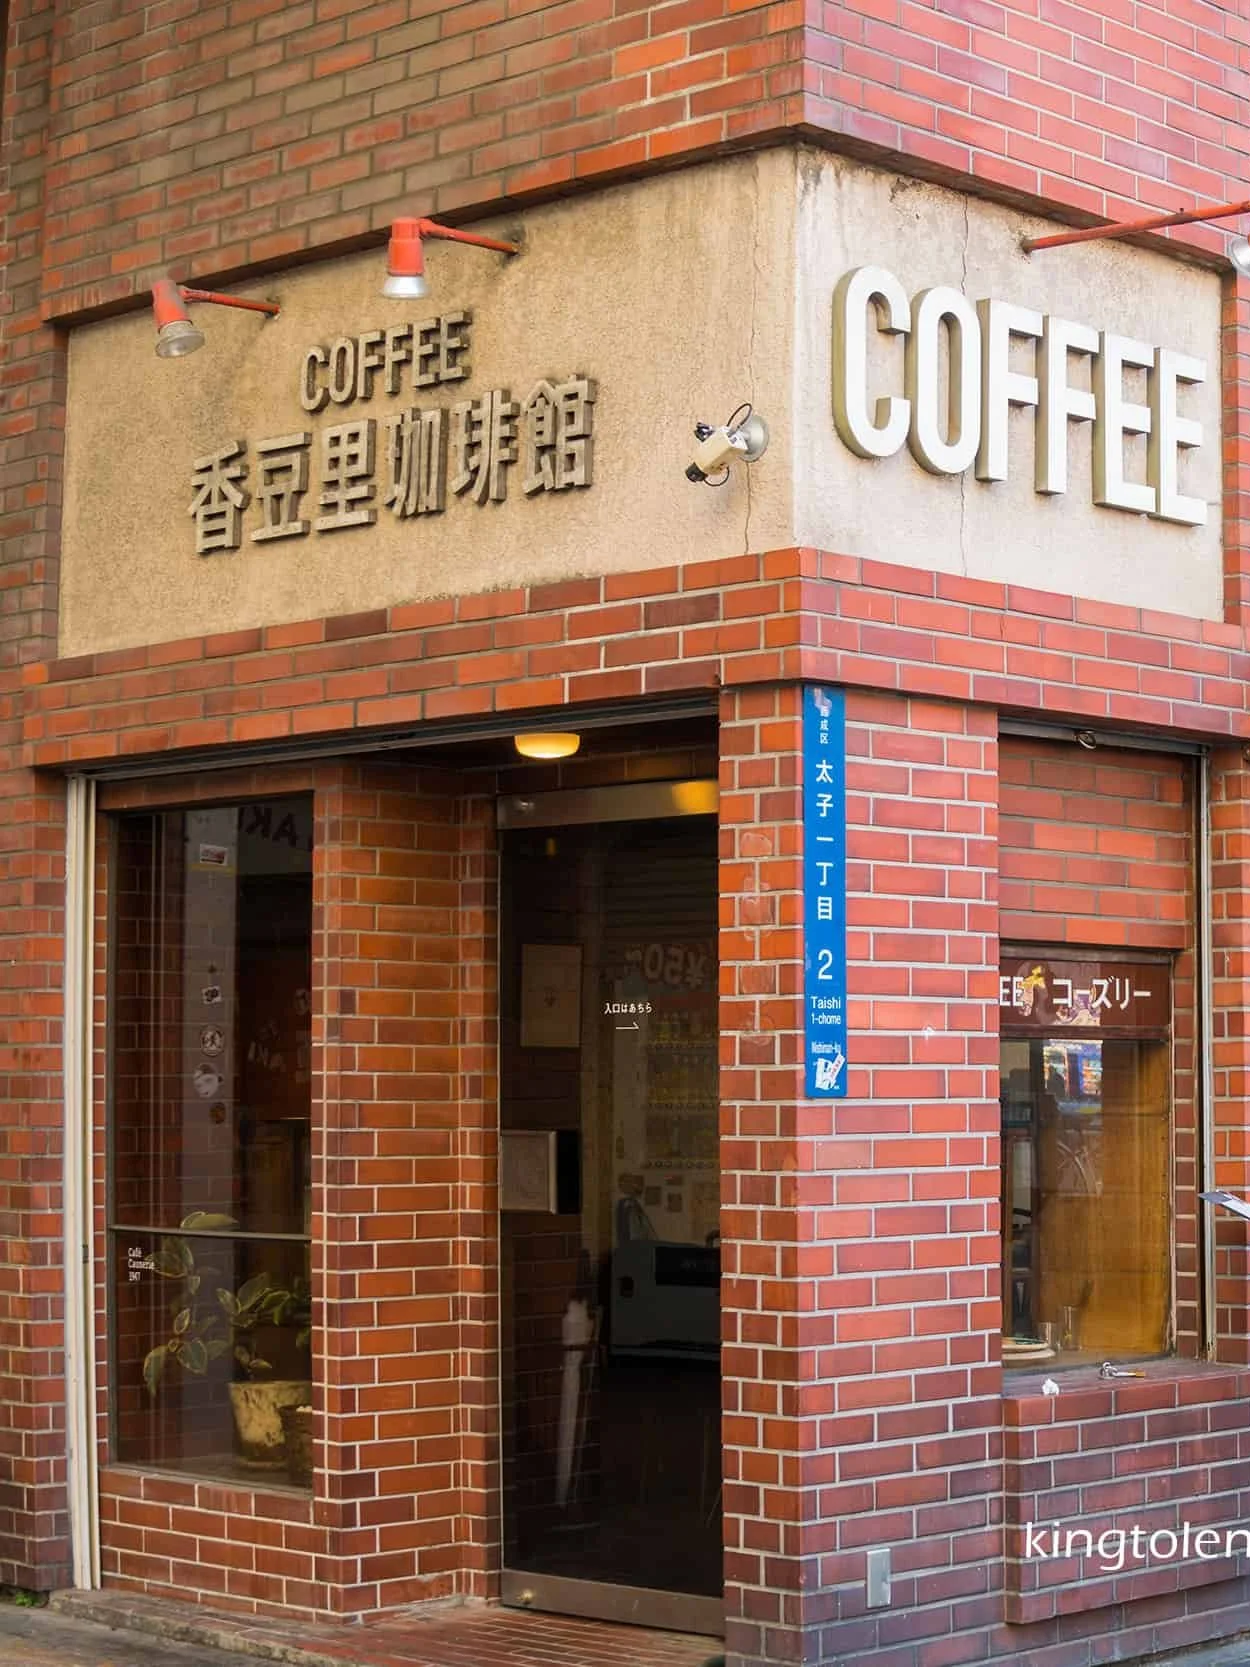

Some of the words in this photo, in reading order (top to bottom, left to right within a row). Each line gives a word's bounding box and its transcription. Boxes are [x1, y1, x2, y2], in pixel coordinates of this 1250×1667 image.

[300, 311, 472, 412] COFFEE
[832, 265, 1207, 527] COFFEE
[188, 374, 595, 554] 香豆里珈琲館
[816, 760, 834, 920] 太子一丁目
[817, 949, 833, 980] 2
[604, 1003, 653, 1014] 入口はあちら
[811, 996, 841, 1009] Taishi
[1053, 976, 1151, 1009] コーズリー
[811, 1013, 841, 1025] 1-chome
